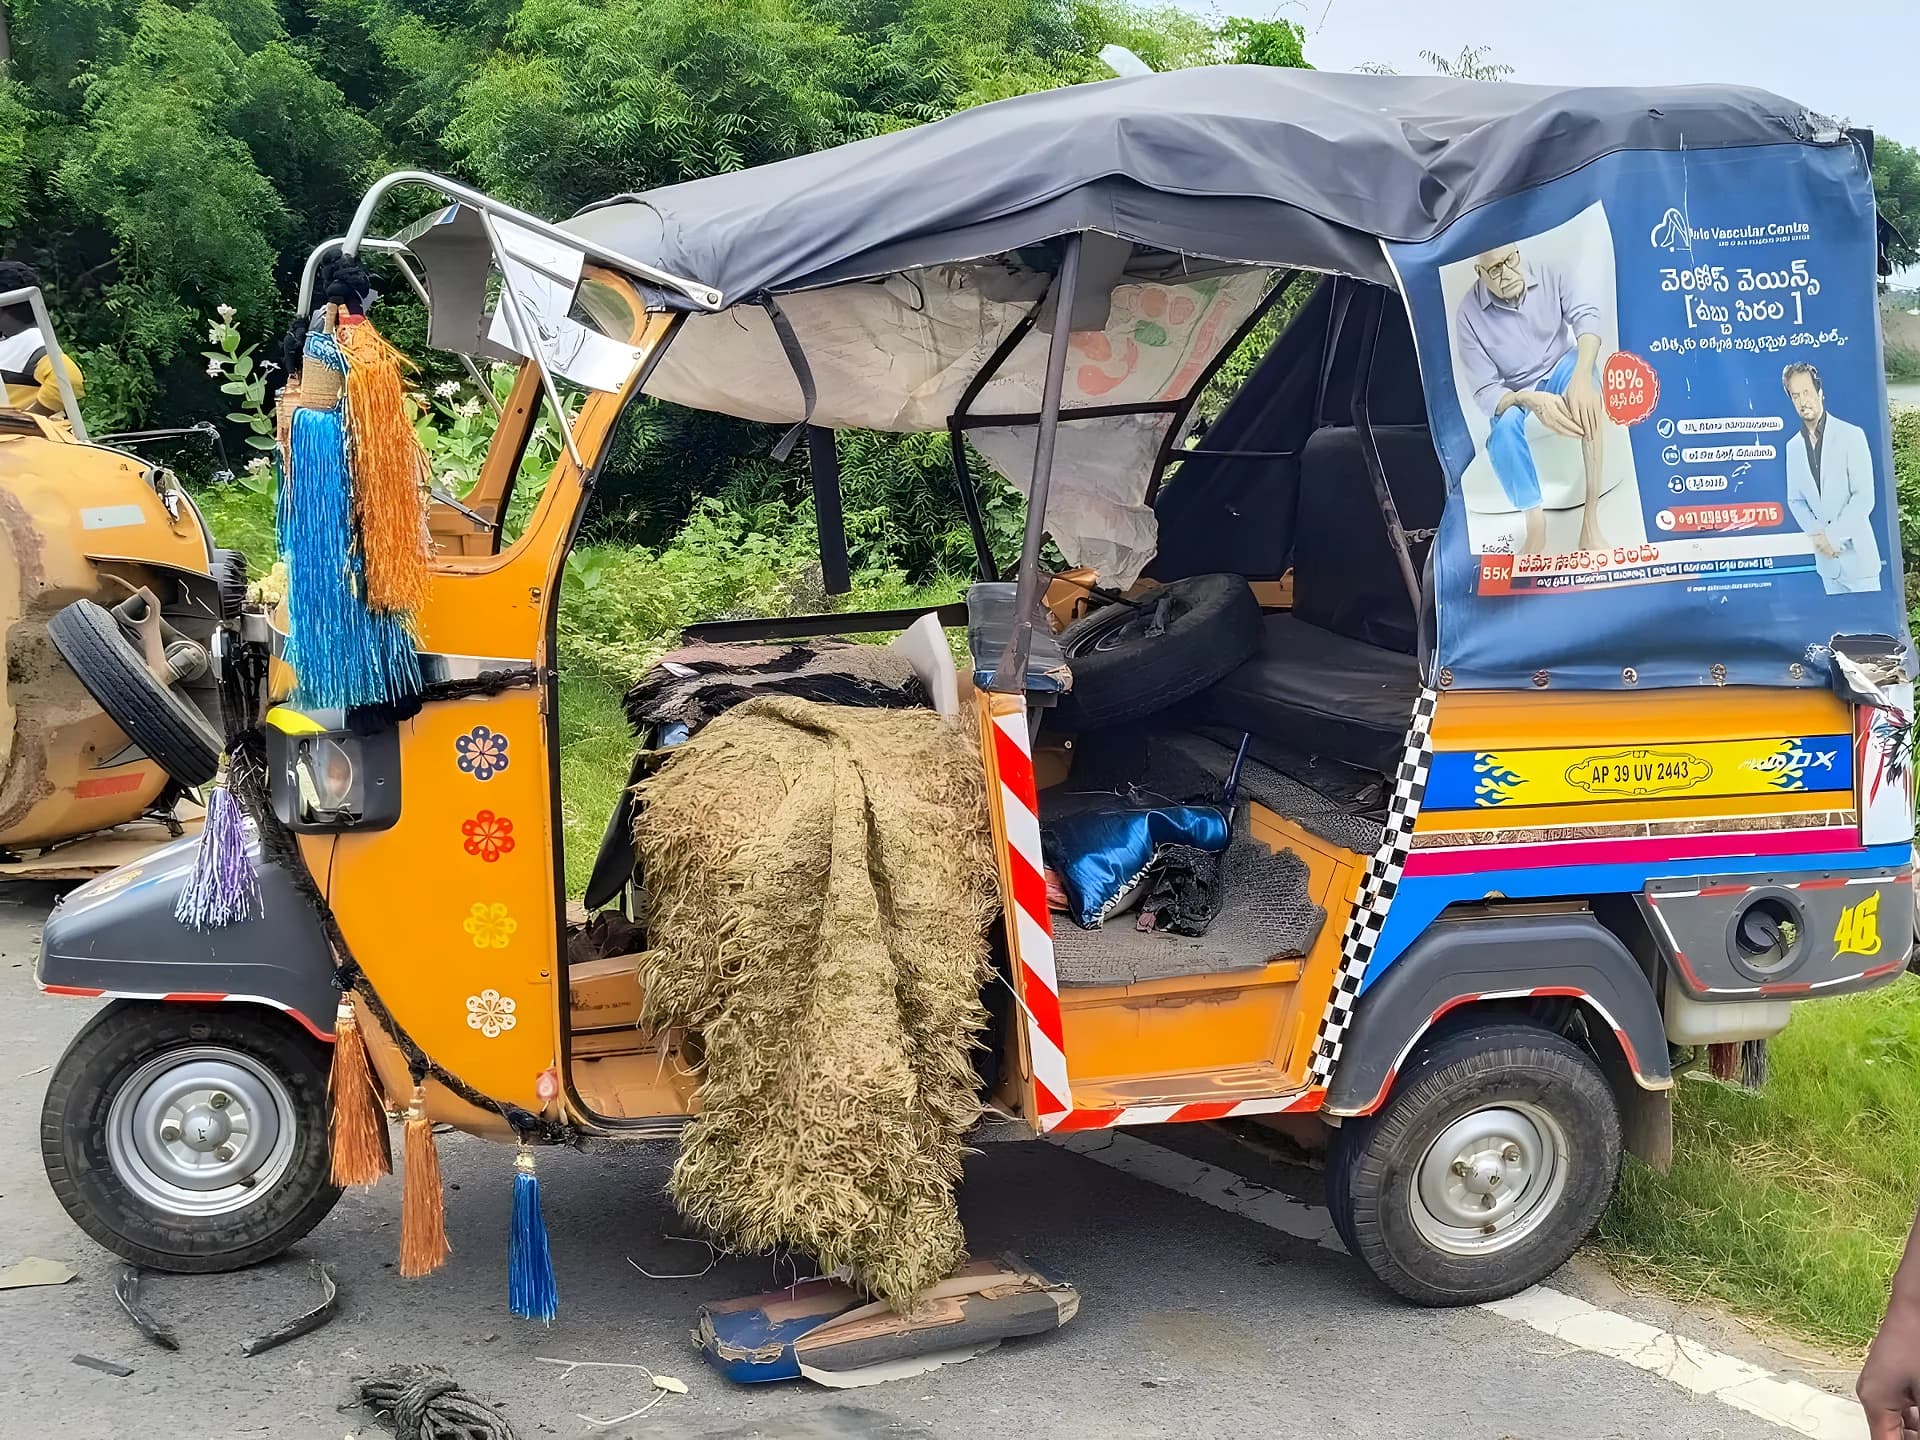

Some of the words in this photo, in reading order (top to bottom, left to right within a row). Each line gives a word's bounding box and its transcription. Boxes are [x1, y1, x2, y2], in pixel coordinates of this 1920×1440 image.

[1711, 225, 1766, 240] Vascular
[1608, 368, 1644, 390] 98%
[1591, 765, 1610, 784] AP
[1614, 765, 1630, 783] 39
[1634, 763, 1654, 782] UV
[1657, 761, 1690, 780] 2443
[1830, 889, 1882, 962] 46
